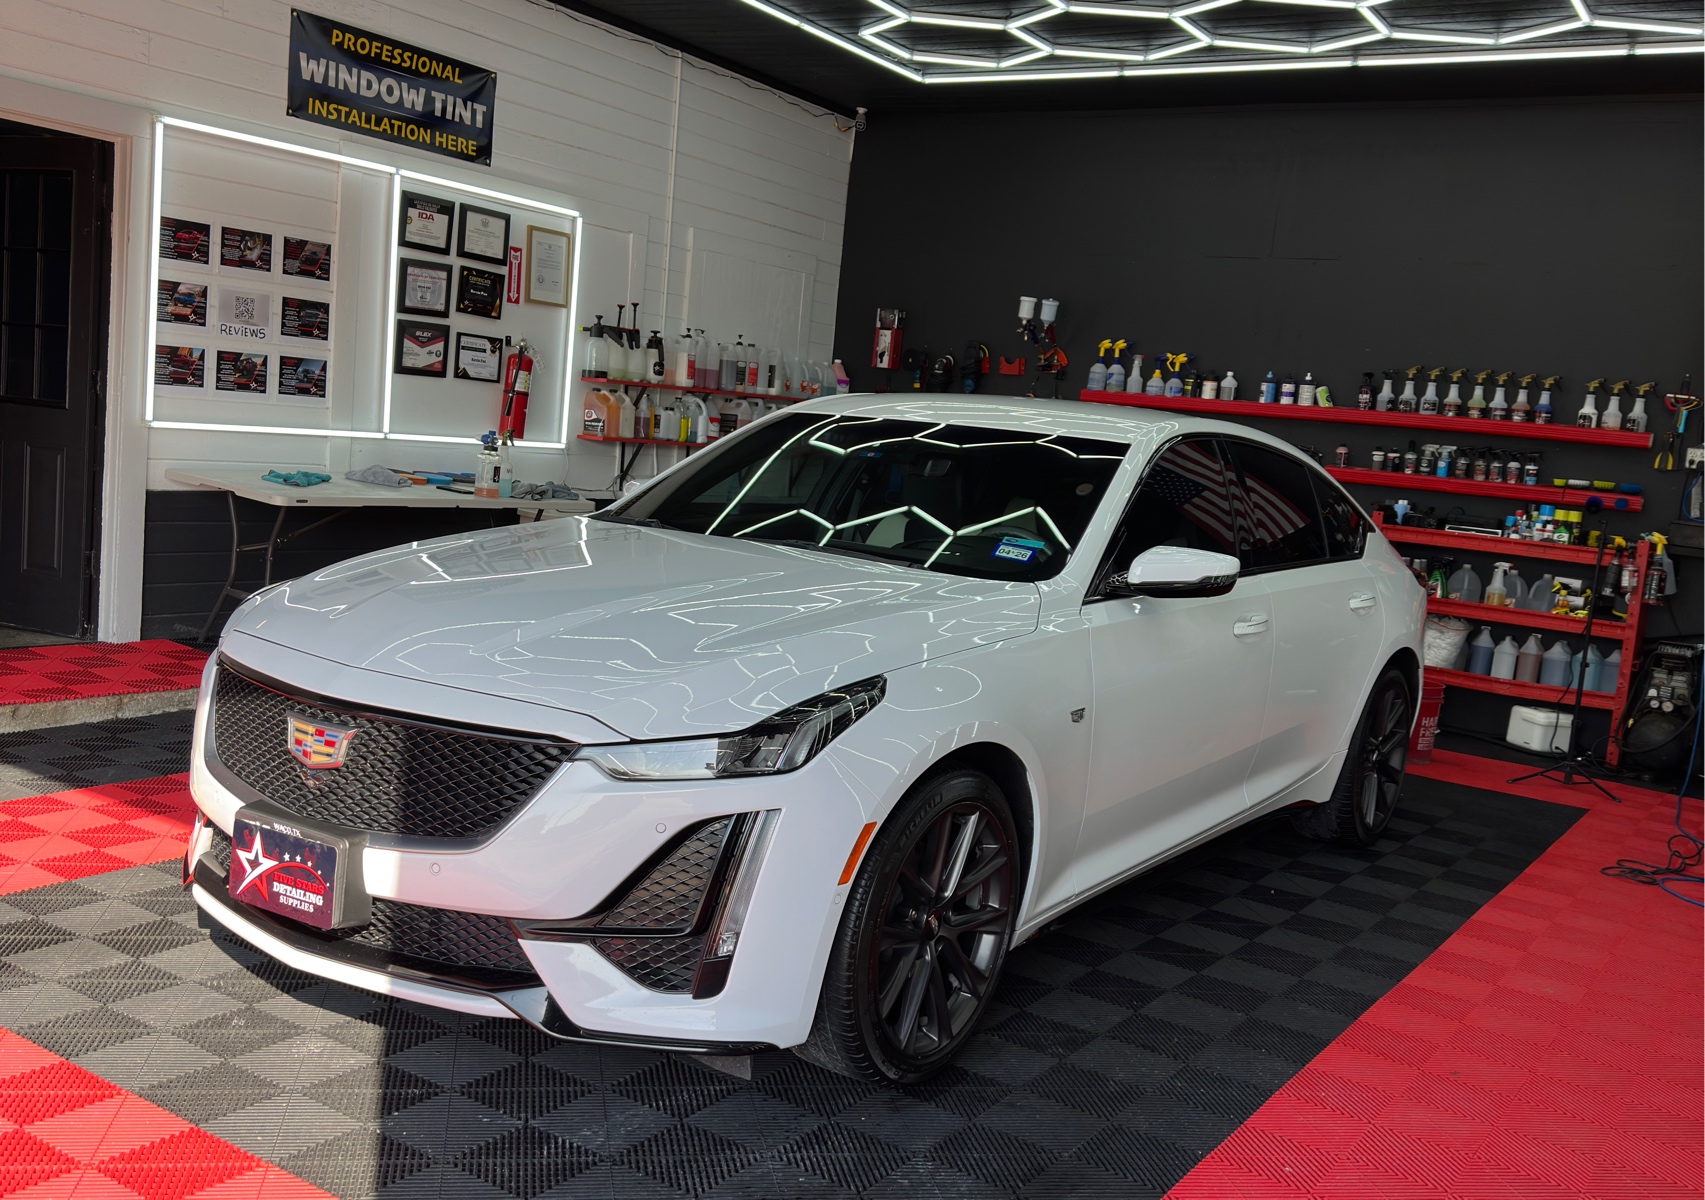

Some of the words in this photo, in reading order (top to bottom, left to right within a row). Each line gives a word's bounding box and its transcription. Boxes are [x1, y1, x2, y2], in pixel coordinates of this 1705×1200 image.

[331, 29, 463, 84] PROFESSIONAL
[299, 51, 426, 112] WINDOW
[431, 90, 487, 128] TINT
[308, 97, 431, 144] INSTALLATION
[435, 131, 477, 156] HERE
[418, 211, 435, 221] IDA
[998, 548, 1011, 556] 04
[1014, 551, 1028, 559] 26
[273, 871, 295, 886] FIVE
[295, 878, 325, 895] STARS
[273, 882, 323, 906] DETAILING
[279, 895, 314, 913] SUPPLIES
